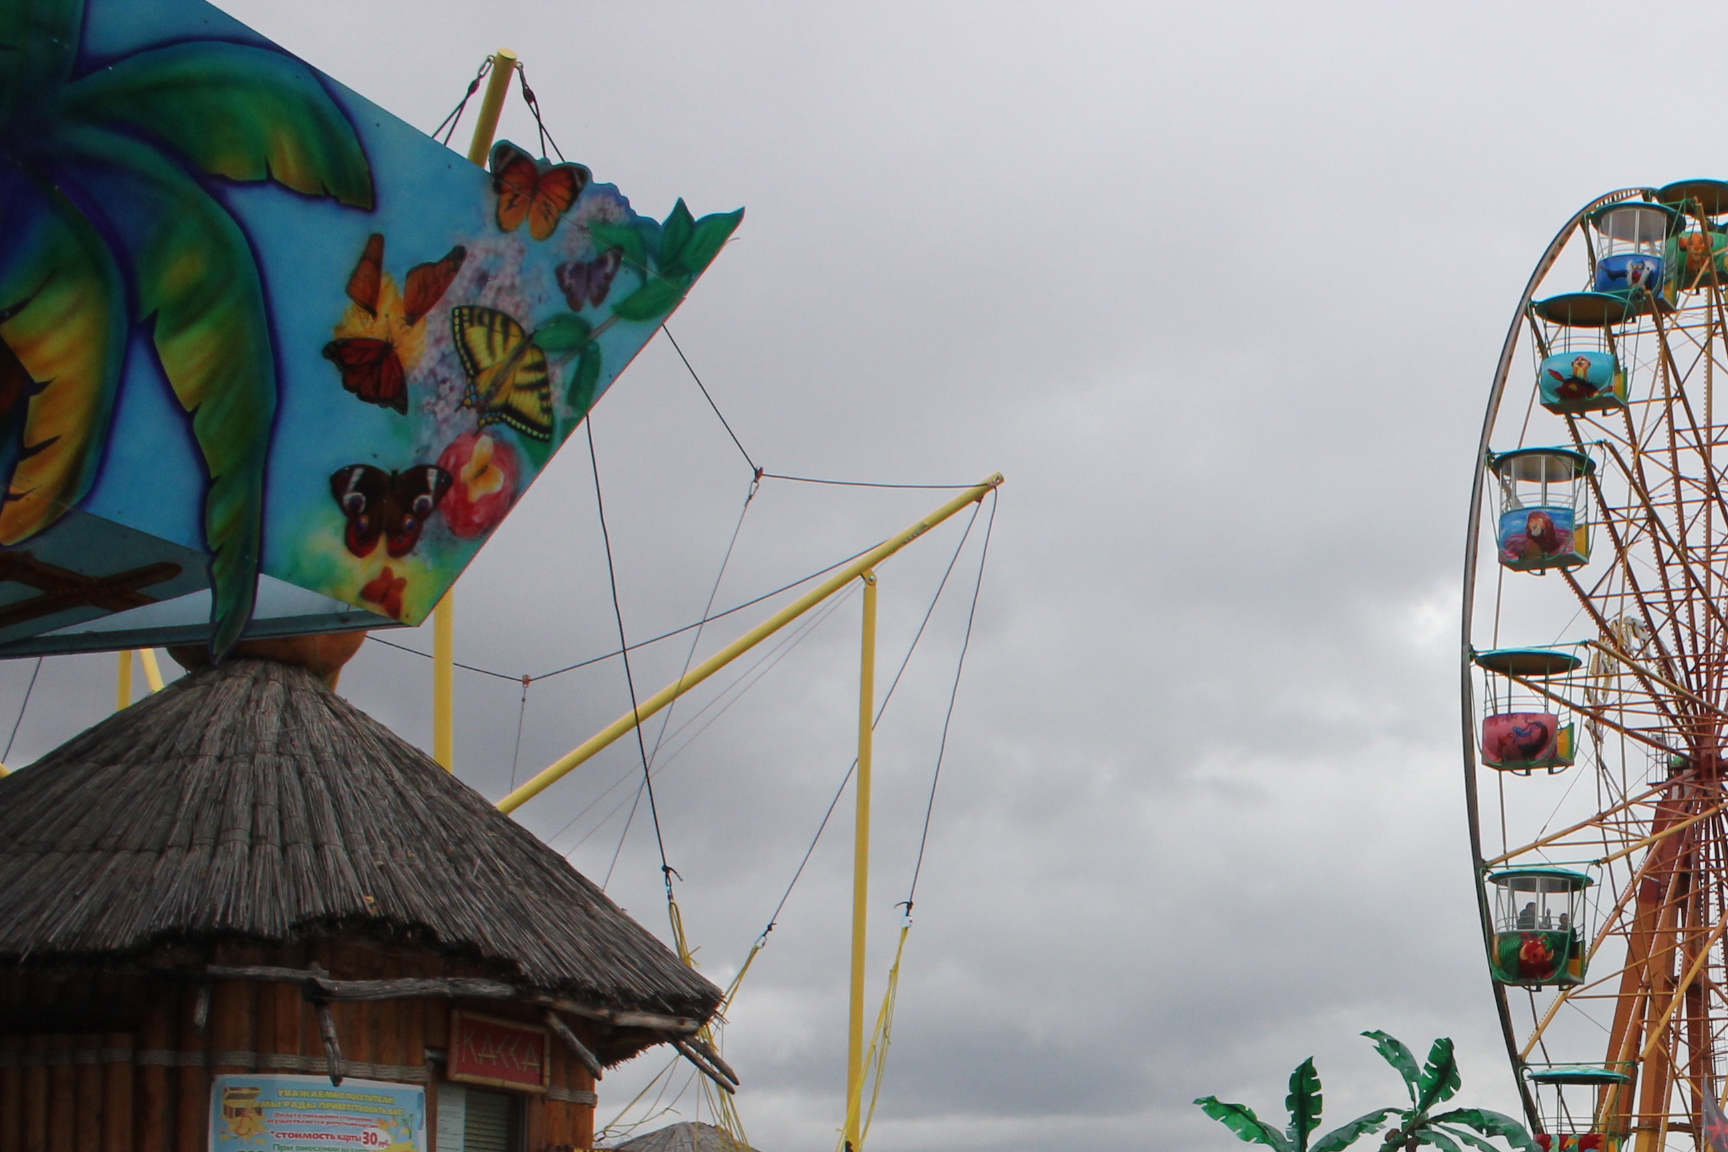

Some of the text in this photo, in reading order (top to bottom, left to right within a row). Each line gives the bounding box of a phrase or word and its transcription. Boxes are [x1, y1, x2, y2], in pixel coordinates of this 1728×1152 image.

[462, 1027, 540, 1074] КАССА
[284, 1101, 316, 1110] РАДЫ
[337, 1134, 362, 1143] карты
[362, 1131, 378, 1145] 30
[272, 1143, 293, 1152] При
